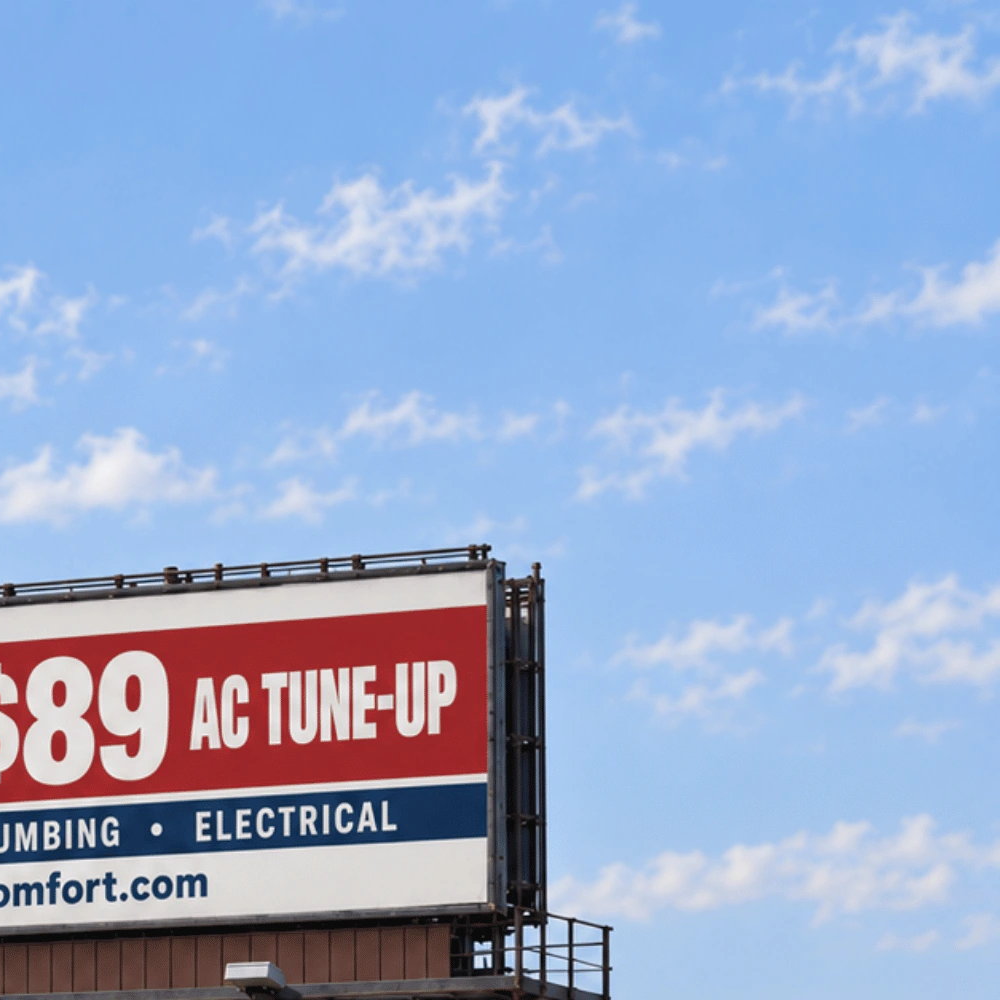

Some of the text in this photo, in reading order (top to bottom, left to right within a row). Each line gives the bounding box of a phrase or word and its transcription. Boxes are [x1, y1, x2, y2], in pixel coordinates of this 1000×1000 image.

[189, 674, 250, 751] AC
[261, 659, 458, 746] TUNE-UP
[195, 800, 398, 843] ELECTRICAL
